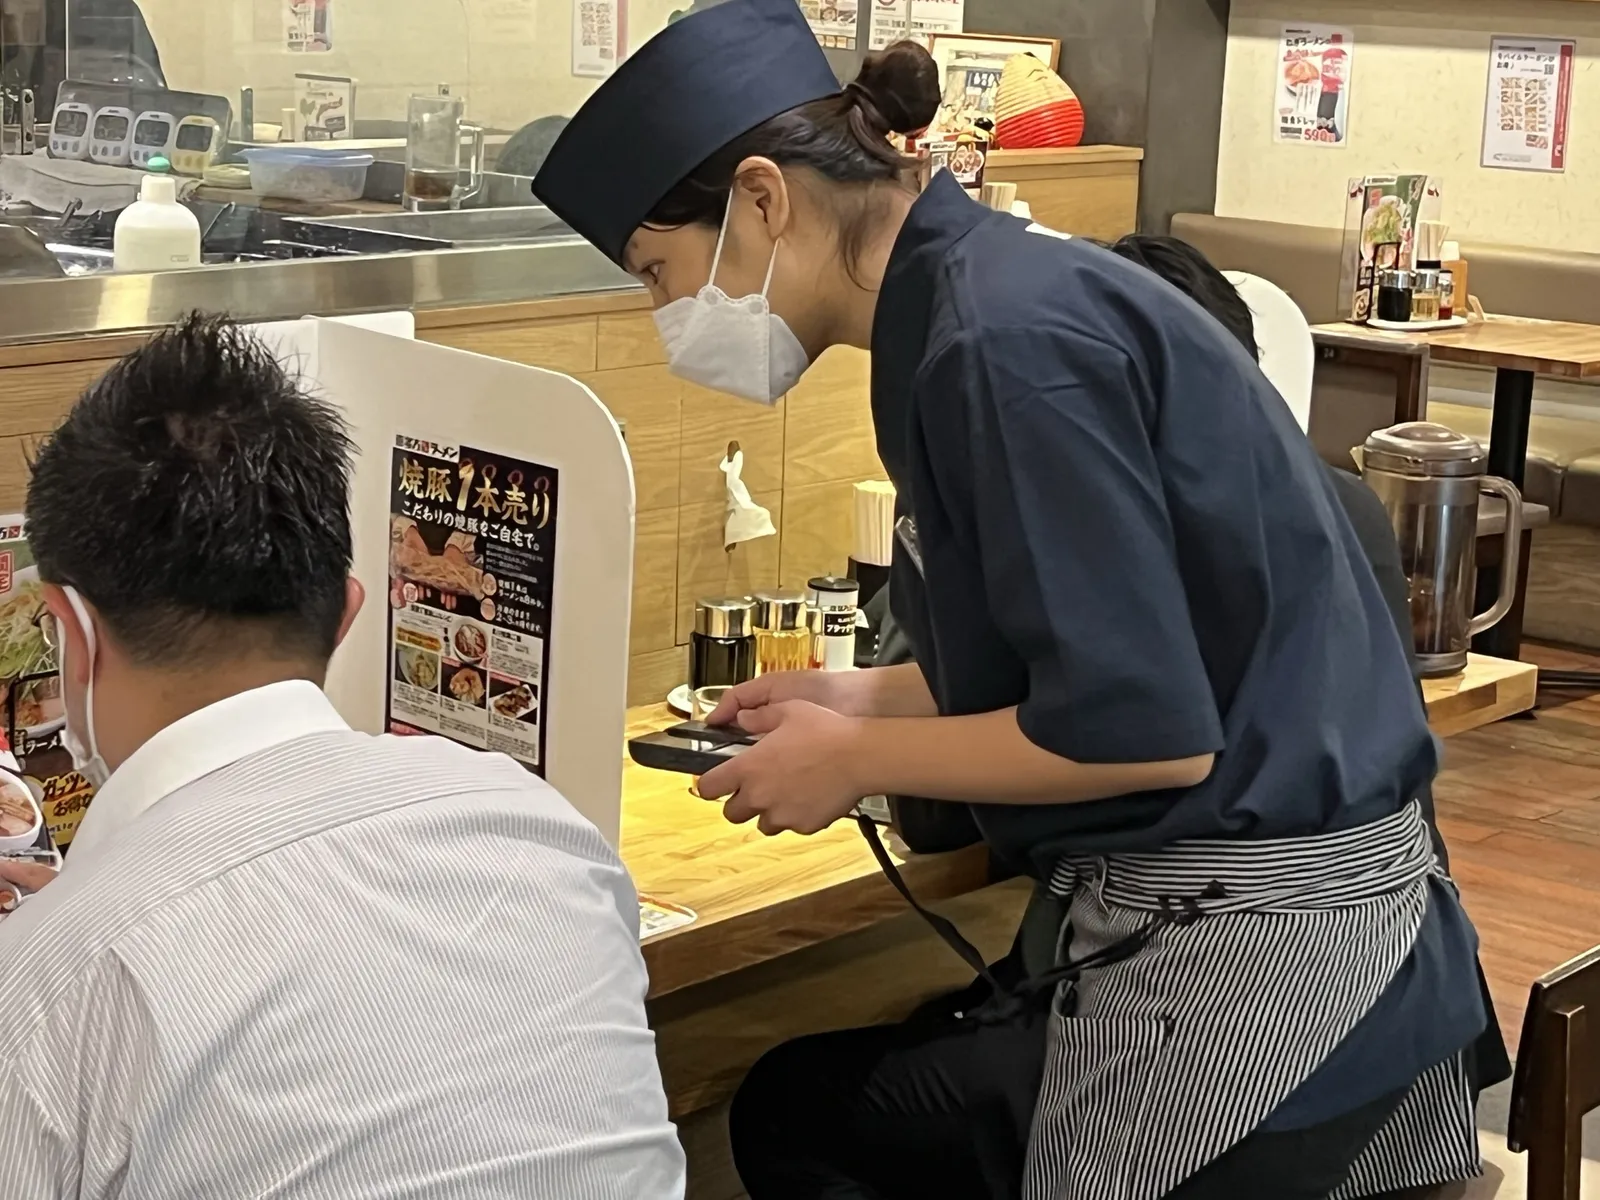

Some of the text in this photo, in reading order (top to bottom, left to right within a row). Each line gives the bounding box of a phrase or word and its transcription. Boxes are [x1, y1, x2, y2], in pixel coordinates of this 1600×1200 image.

[398, 457, 550, 530] 焼豚1本売り
